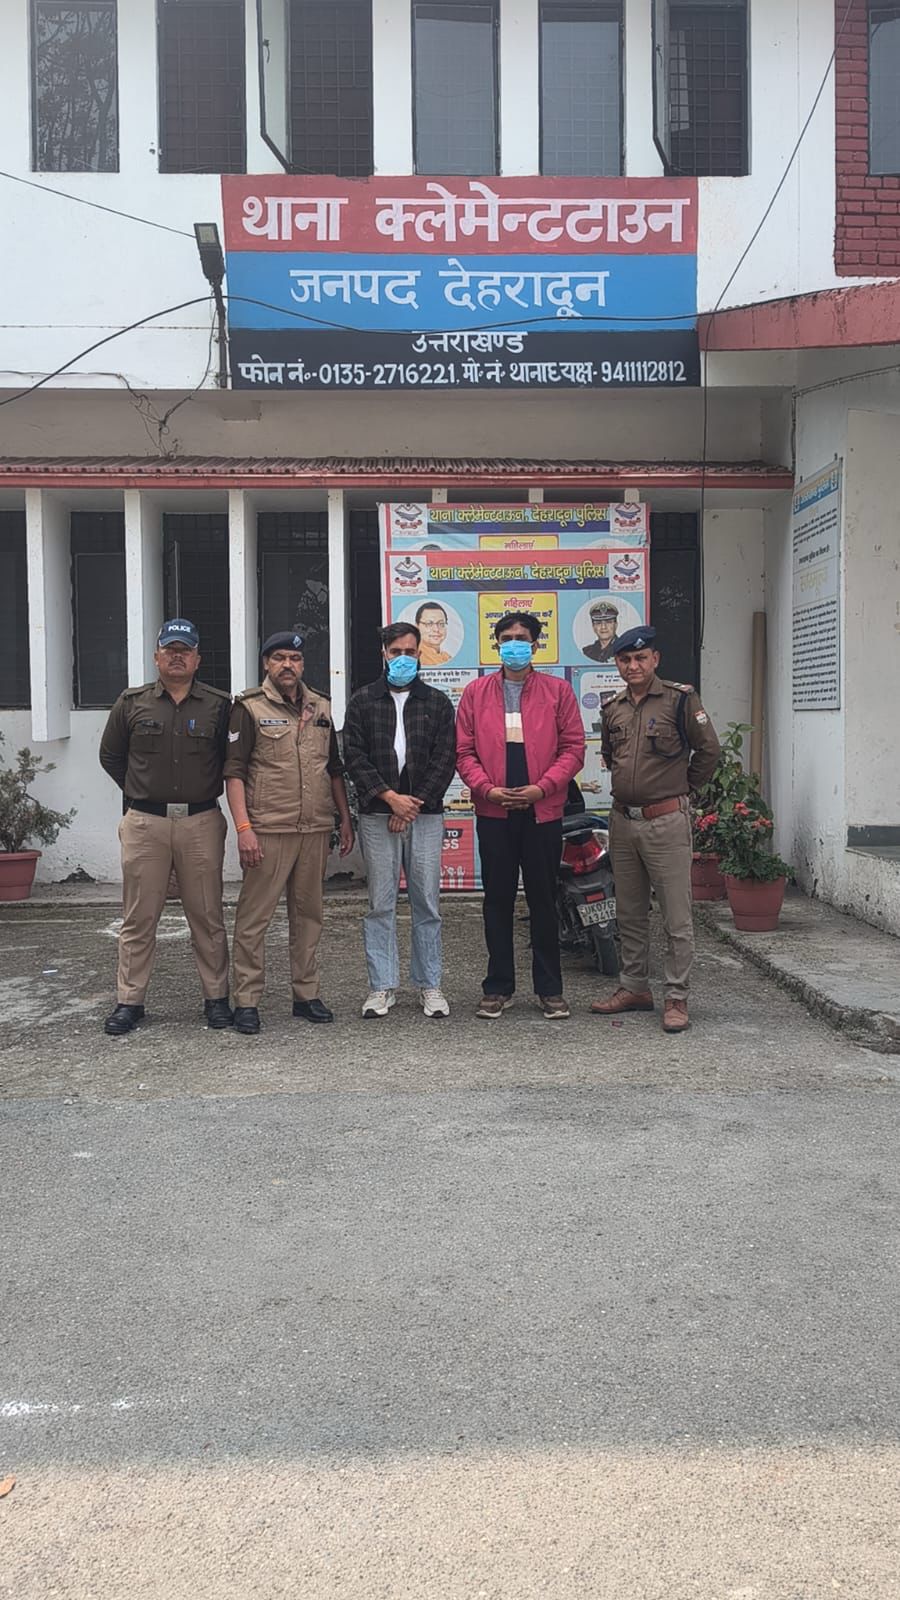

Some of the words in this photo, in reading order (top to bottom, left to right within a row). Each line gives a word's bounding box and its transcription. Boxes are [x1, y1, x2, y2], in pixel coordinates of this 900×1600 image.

[242, 196, 348, 241] थाना
[375, 181, 691, 243] क्लेमेन्टटाउन
[289, 269, 421, 309] जनपद
[438, 258, 610, 320] देहरादून
[238, 354, 285, 384] फोन
[430, 508, 455, 522] थाना
[531, 504, 573, 527] देहरादून
[575, 503, 608, 527] पुलिस
[429, 566, 454, 580] थाना
[531, 562, 573, 585] देहरादून
[575, 560, 606, 585] पुलिस
[168, 624, 190, 632] POLICE
[446, 830, 459, 838] TO
